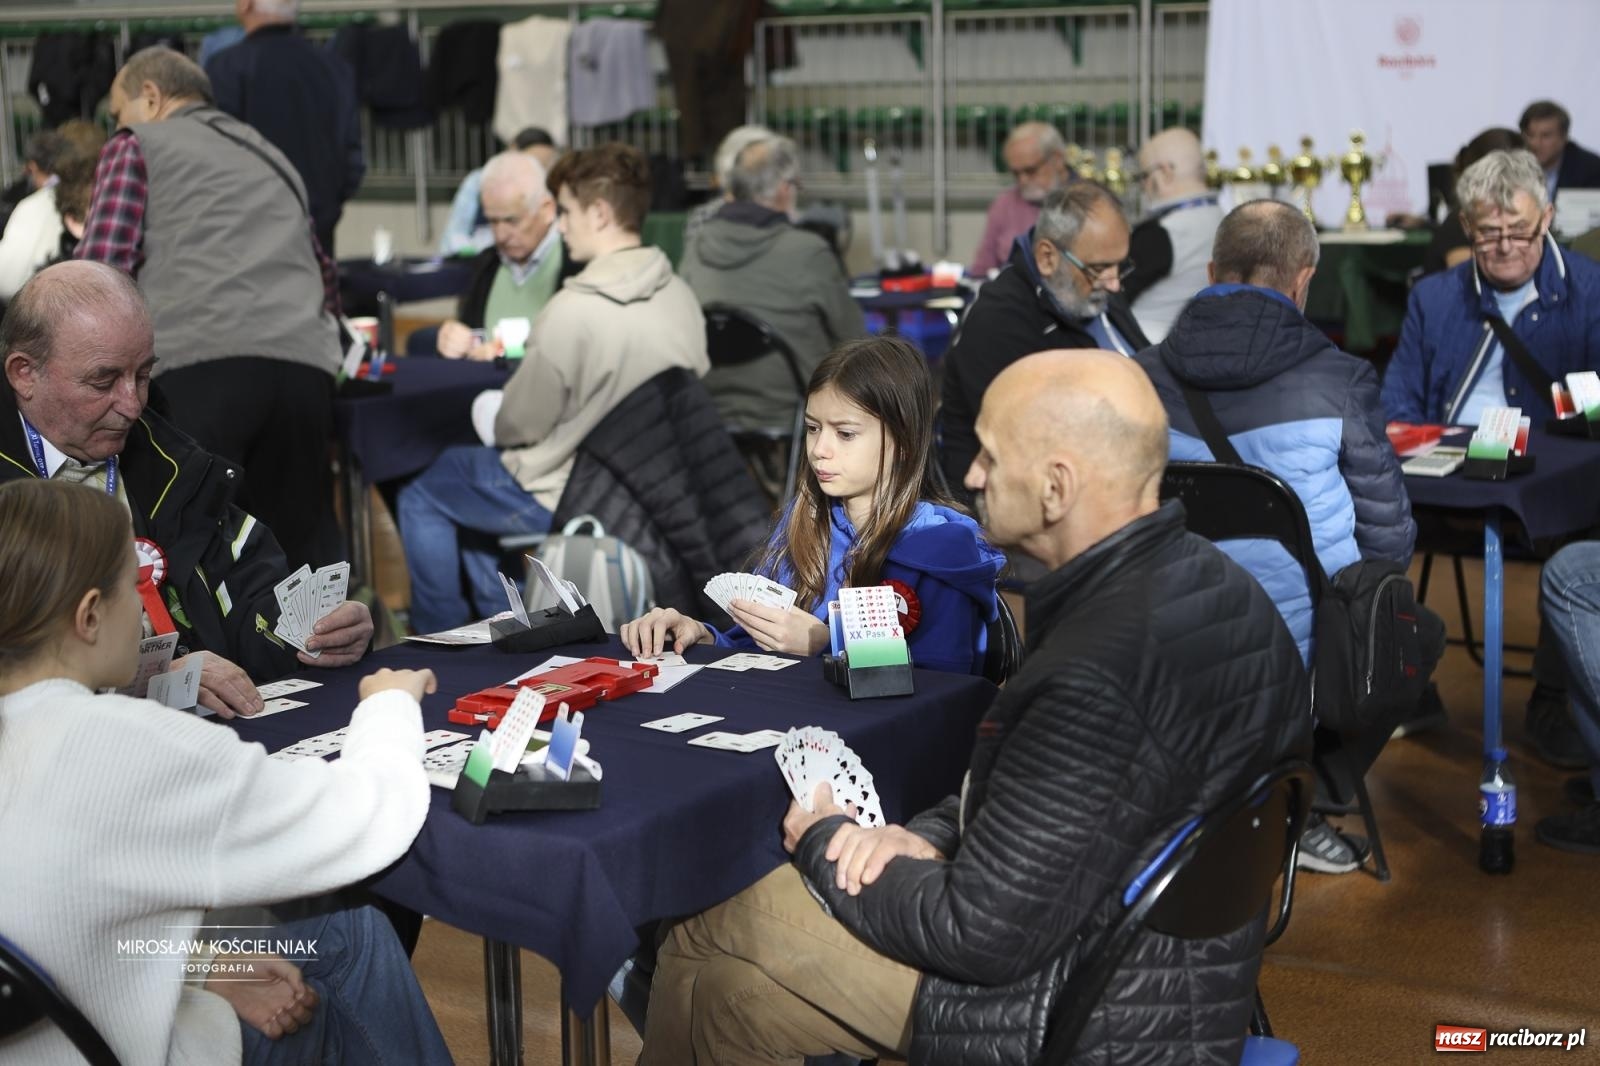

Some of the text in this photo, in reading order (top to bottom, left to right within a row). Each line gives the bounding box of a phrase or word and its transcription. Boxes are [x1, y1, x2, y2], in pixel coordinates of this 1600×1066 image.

[850, 627, 899, 640] XX Pass X
